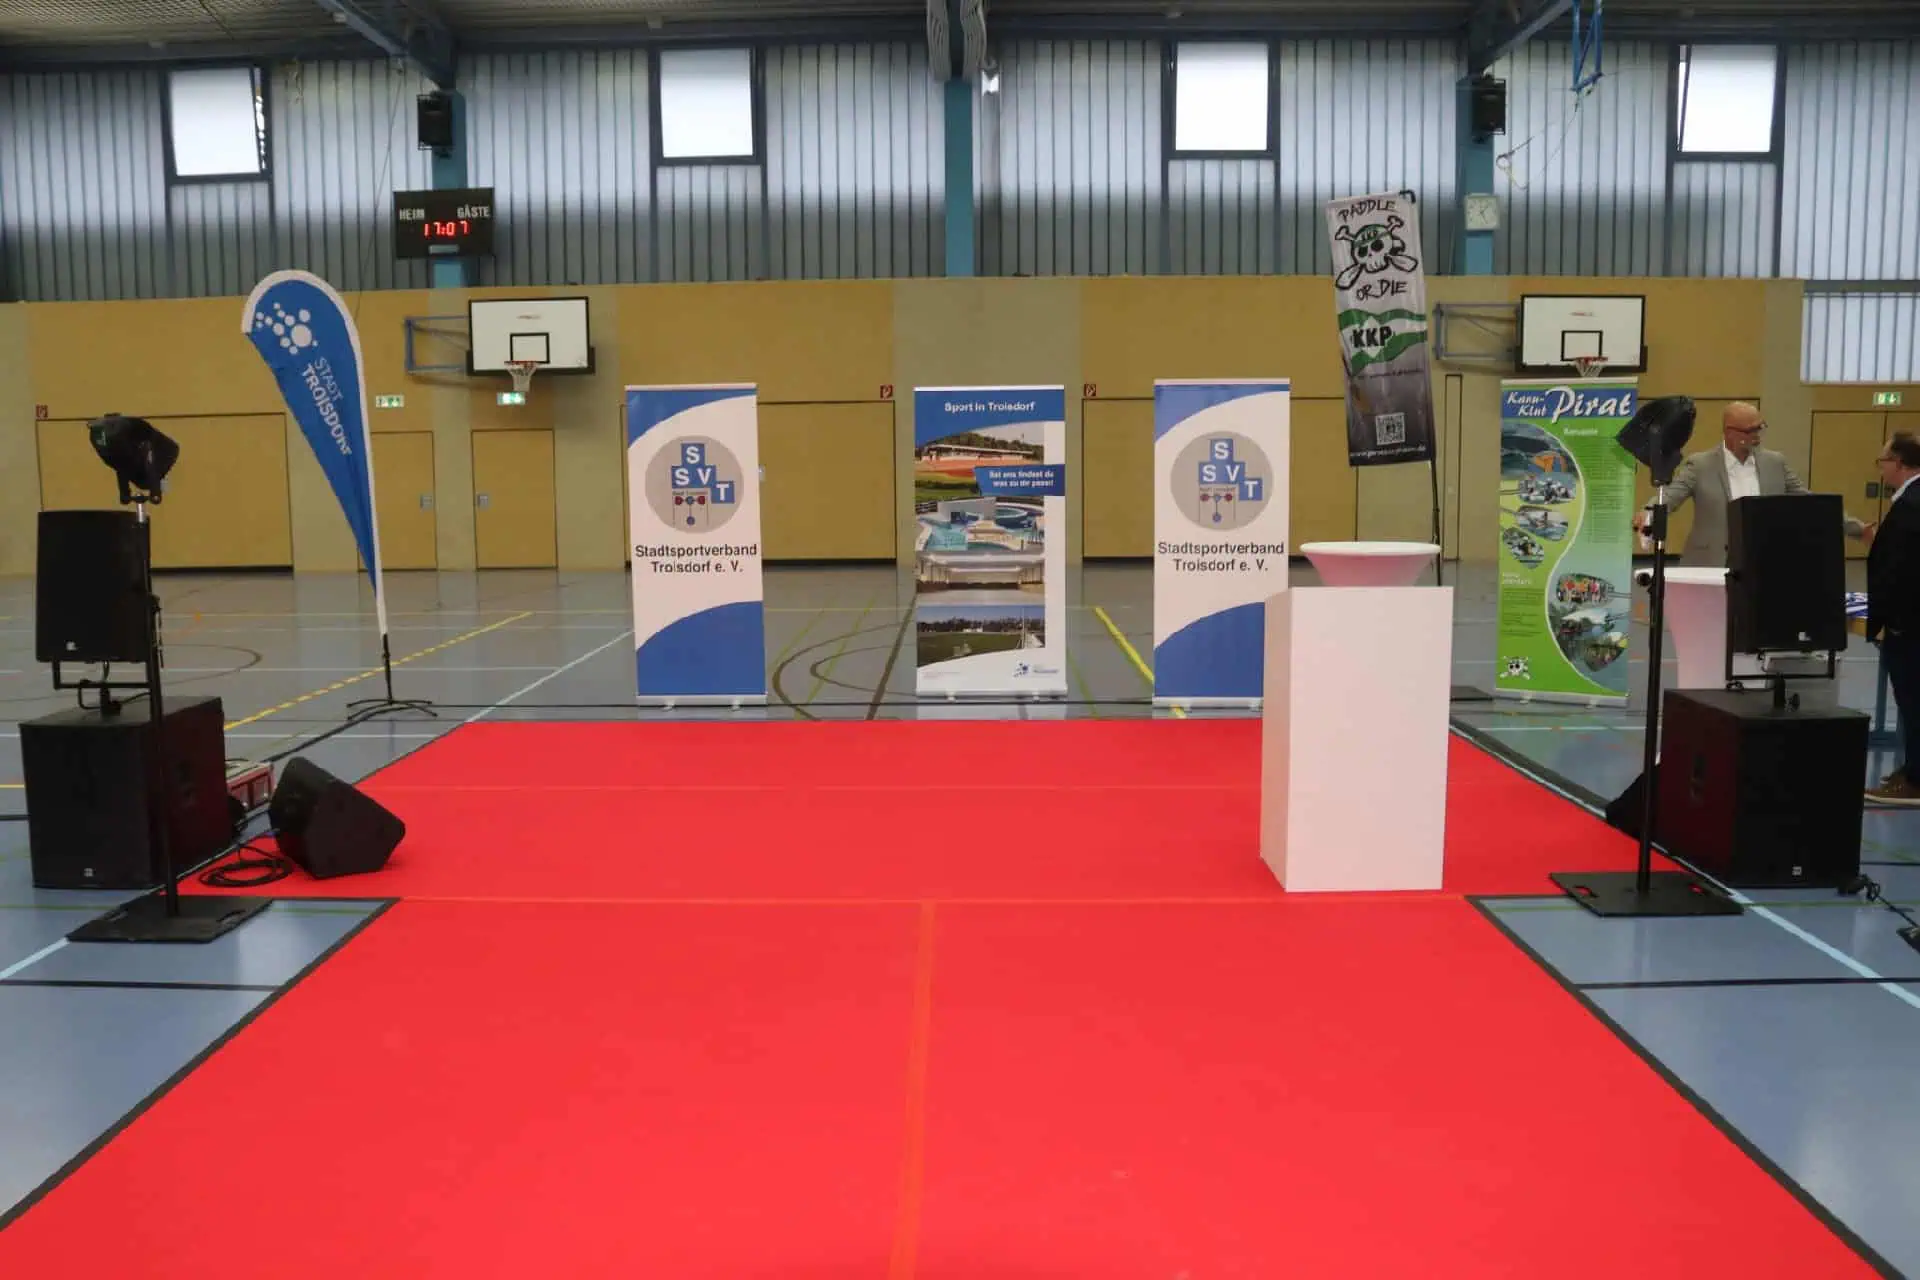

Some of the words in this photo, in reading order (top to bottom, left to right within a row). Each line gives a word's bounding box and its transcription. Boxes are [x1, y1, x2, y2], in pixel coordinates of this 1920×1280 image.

[400, 208, 425, 220] HEIM
[1338, 199, 1400, 222] PADDLE
[1356, 284, 1372, 300] OR
[1377, 279, 1407, 297] DIE
[1352, 326, 1392, 348] KKP
[314, 357, 343, 402] STADT
[302, 363, 352, 455] TROISDORF
[944, 402, 973, 413] Sport
[975, 402, 985, 411] in
[988, 401, 1036, 412] Troisdorf
[1545, 386, 1631, 424] Pirat
[686, 446, 700, 464] S
[1214, 442, 1229, 460] S
[674, 468, 690, 485] S
[697, 468, 712, 485] V
[1202, 464, 1217, 482] S
[1225, 465, 1240, 482] V
[716, 483, 730, 501] T
[1244, 480, 1259, 498] T
[635, 544, 757, 558] Stadtsportverband
[1158, 541, 1284, 556] Stadtsportverband
[652, 561, 710, 573] Troisdorf
[715, 564, 726, 573] e.
[731, 560, 744, 573] V.
[1174, 558, 1235, 572] Troisdorf
[1239, 561, 1251, 571] e.
[1257, 558, 1268, 571] V.
